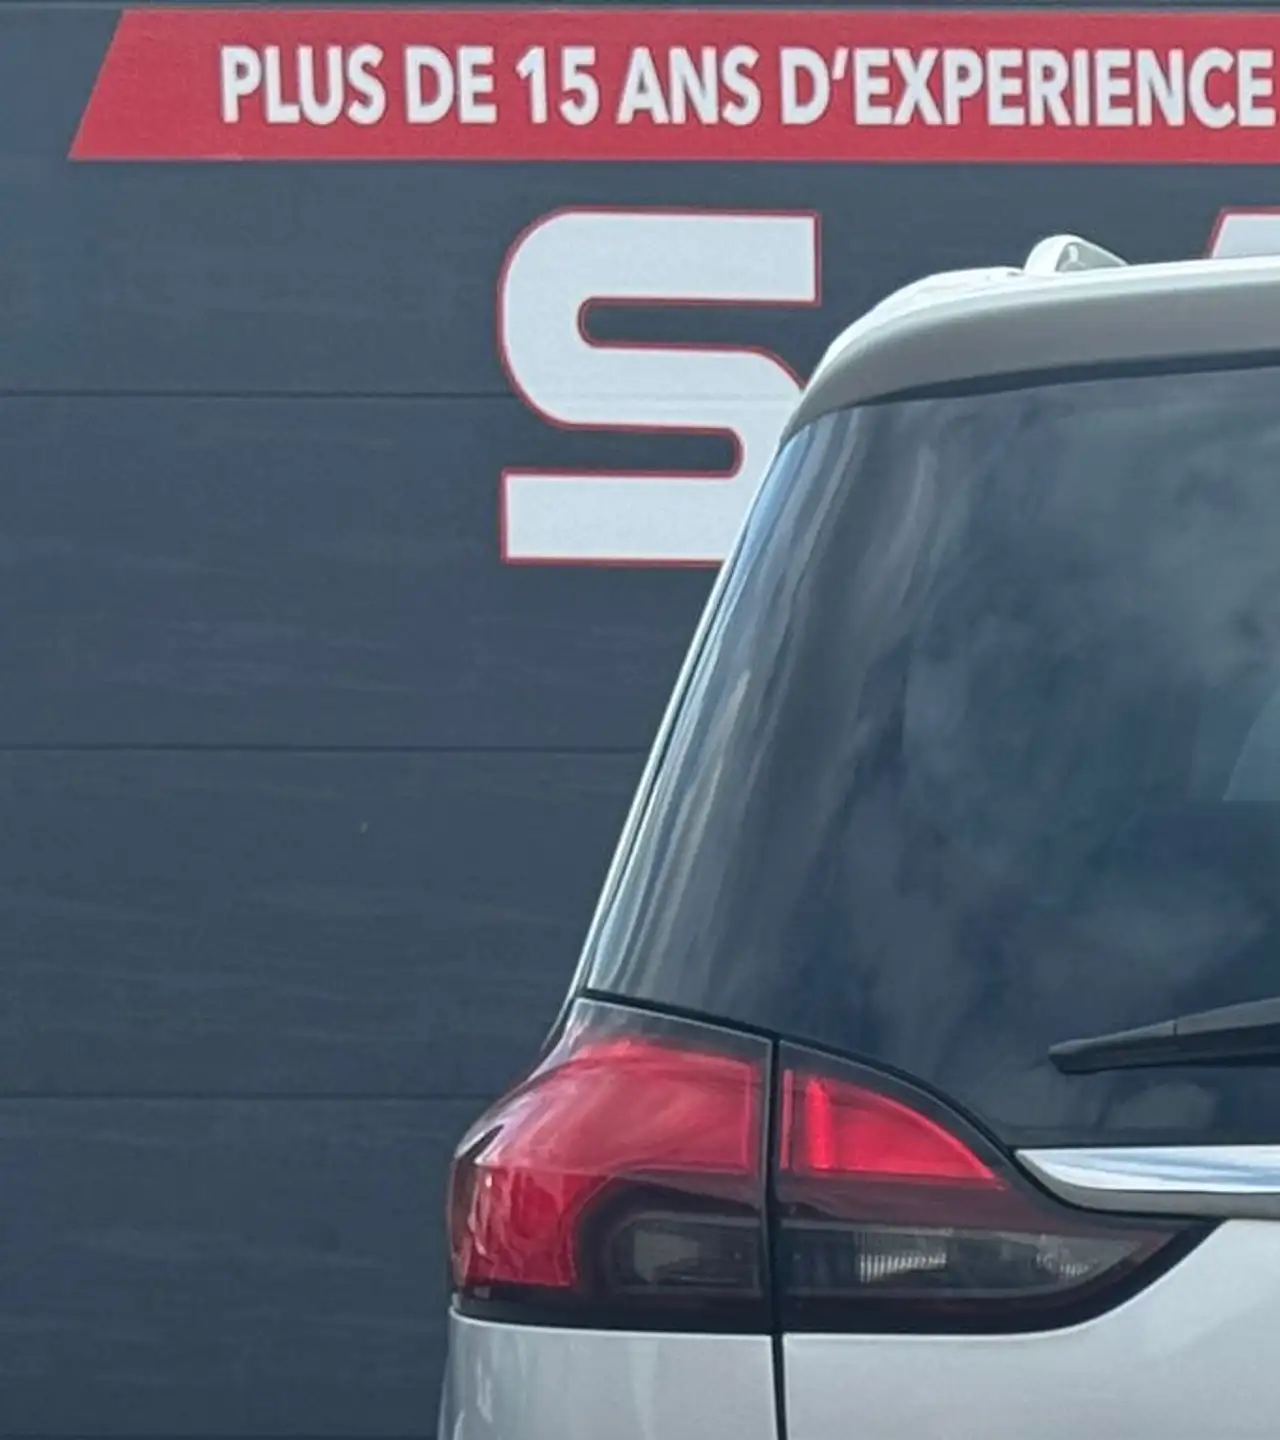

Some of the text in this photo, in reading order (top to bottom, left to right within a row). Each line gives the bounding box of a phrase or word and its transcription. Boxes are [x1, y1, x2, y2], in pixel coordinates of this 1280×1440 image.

[220, 44, 388, 127] PLUS
[404, 46, 498, 126] DE
[516, 46, 601, 127] 15
[616, 46, 762, 127] ANS
